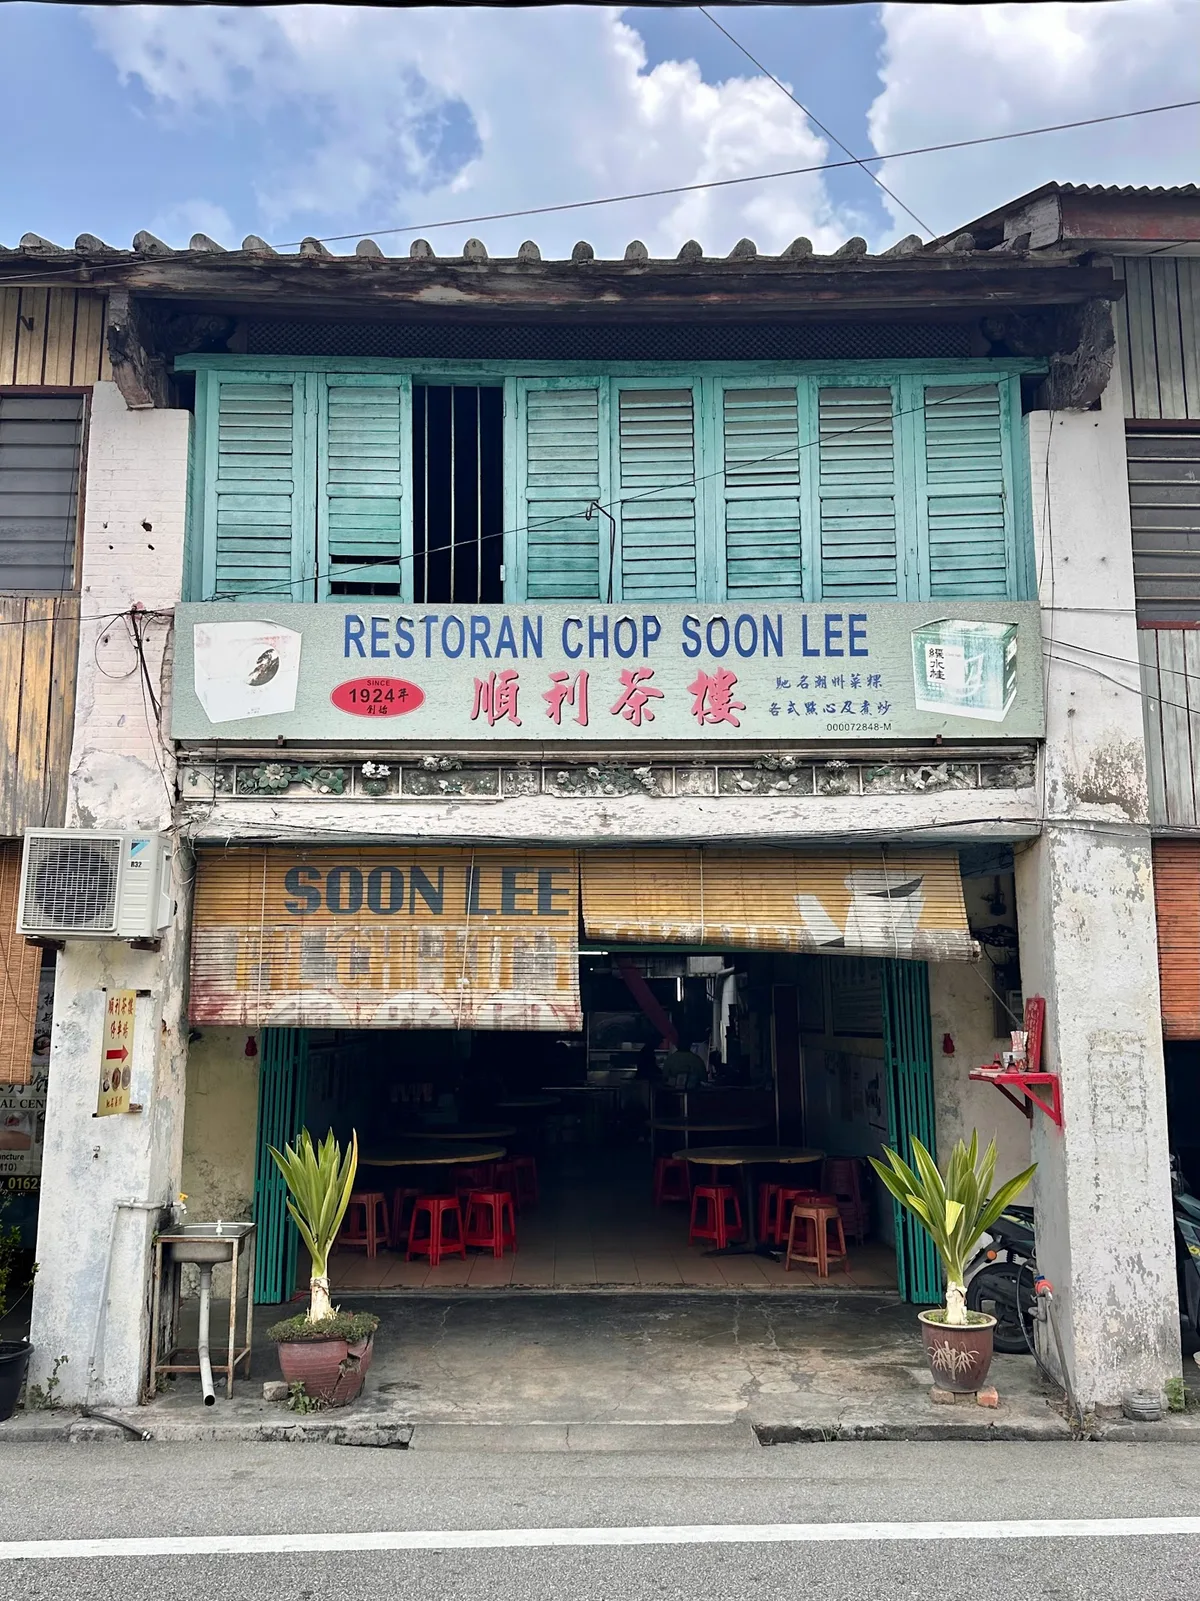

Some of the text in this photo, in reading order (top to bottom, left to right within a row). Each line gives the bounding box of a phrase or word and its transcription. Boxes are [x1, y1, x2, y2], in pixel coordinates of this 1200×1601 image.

[344, 612, 869, 659] RESTORAN CHOP SOON LEE
[366, 679, 391, 687] SINCE
[470, 667, 747, 728] 順利茶樓
[366, 704, 388, 715] 創始
[826, 723, 892, 732] 000072848-M
[284, 865, 570, 916] SOON LEE
[20, 1099, 47, 1109] CEN
